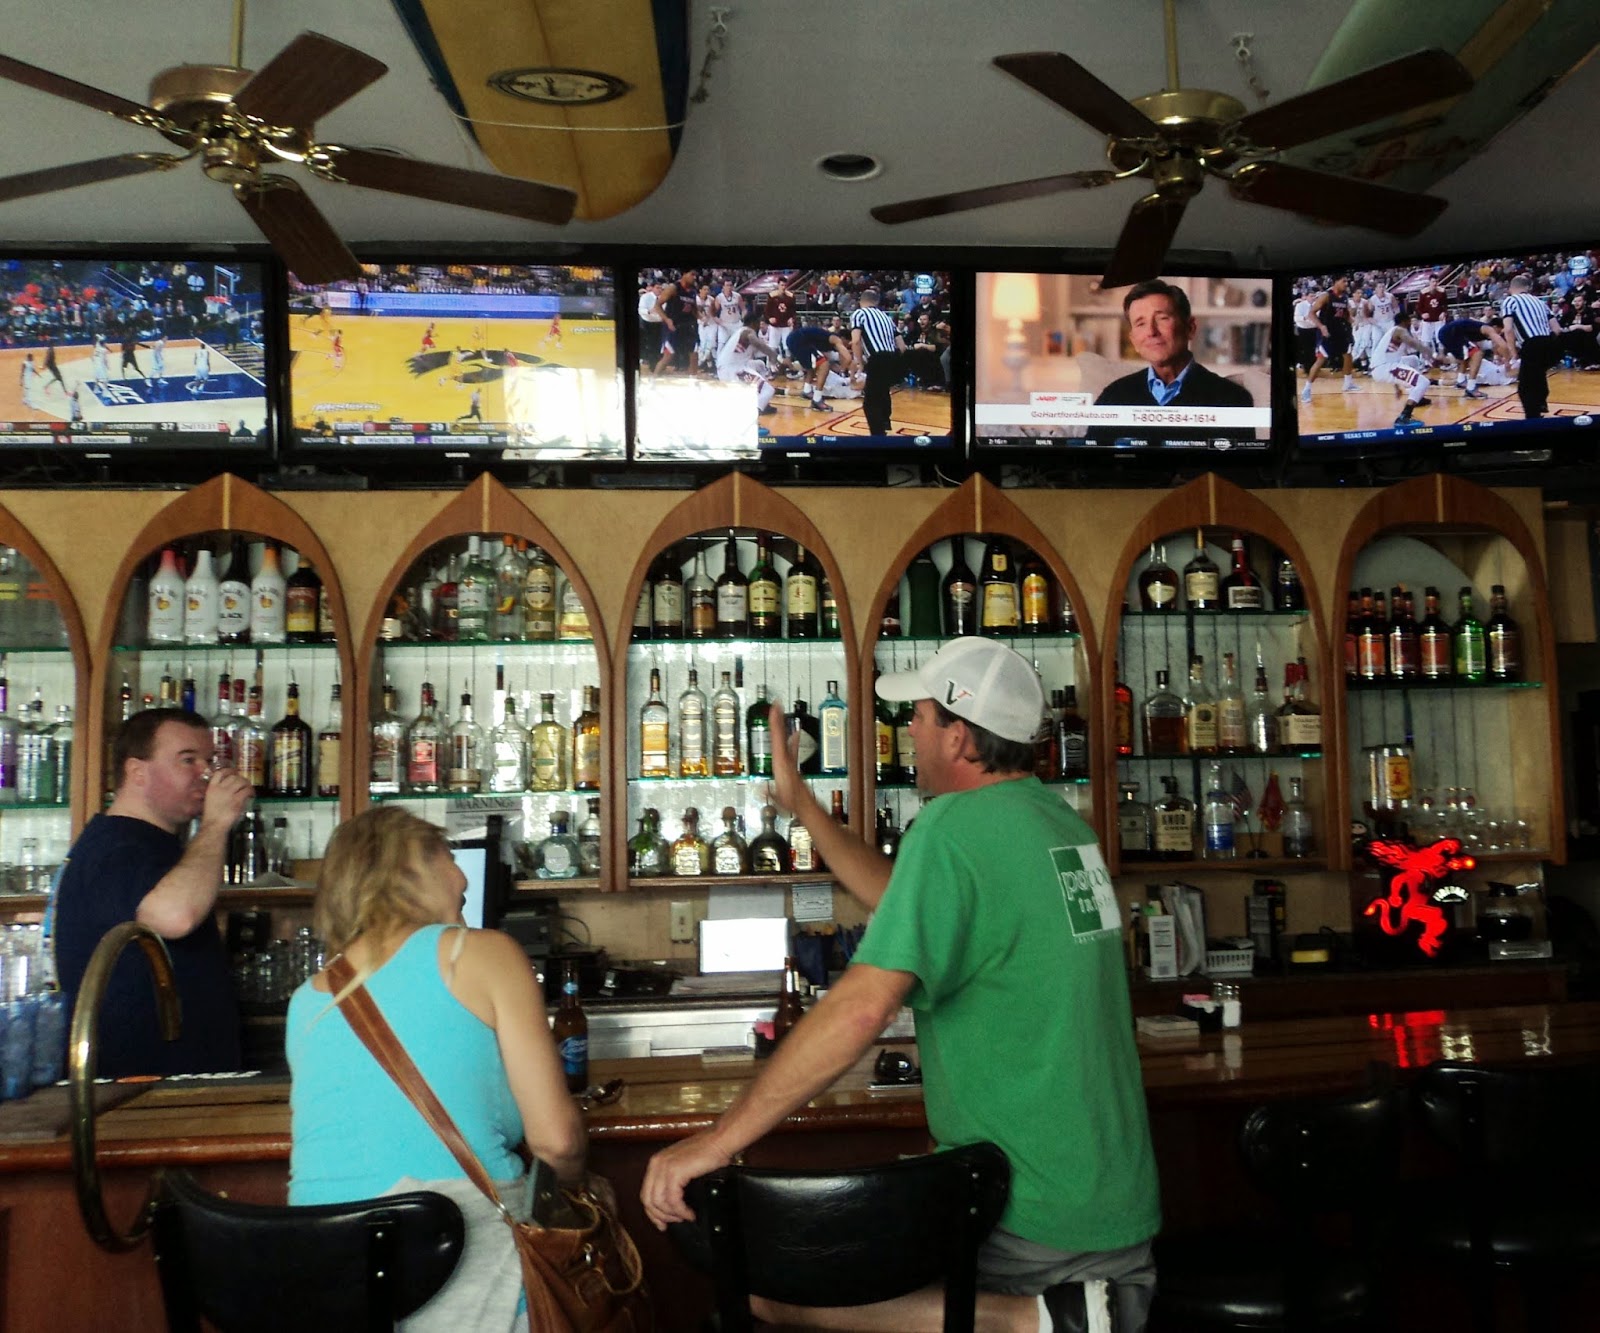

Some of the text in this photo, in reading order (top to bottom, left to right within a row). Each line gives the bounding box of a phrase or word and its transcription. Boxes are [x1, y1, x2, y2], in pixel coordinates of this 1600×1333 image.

[1030, 410, 1119, 419] GoHartfordAuto.com
[1132, 412, 1217, 423] 1-800-684-1614
[1343, 432, 1361, 440] TEXAS
